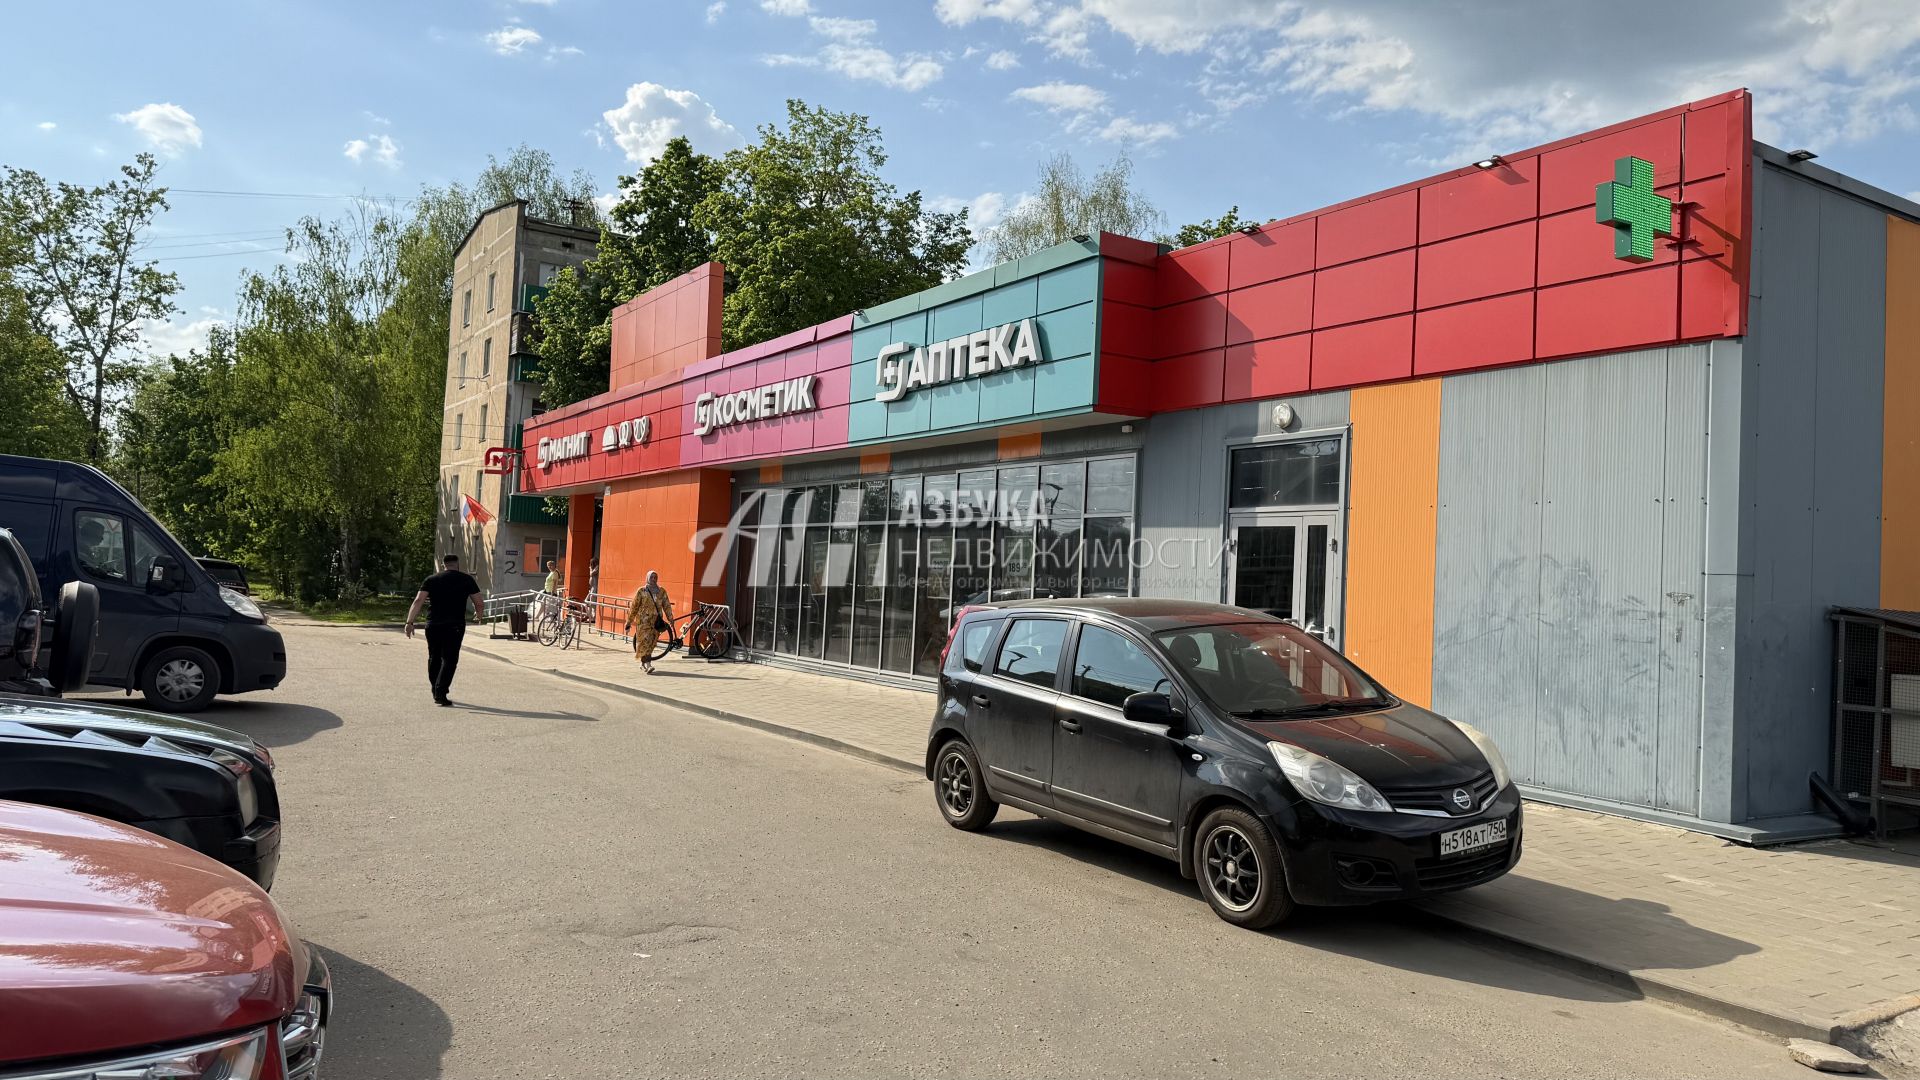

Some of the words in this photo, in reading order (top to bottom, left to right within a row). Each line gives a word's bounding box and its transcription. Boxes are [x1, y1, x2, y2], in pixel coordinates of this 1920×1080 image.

[906, 318, 1043, 389] АПТЕКА
[712, 376, 815, 427] КОСМЕТИК
[549, 431, 590, 462] МАГНИТ
[504, 560, 517, 575] 2
[1488, 821, 1504, 837] 750
